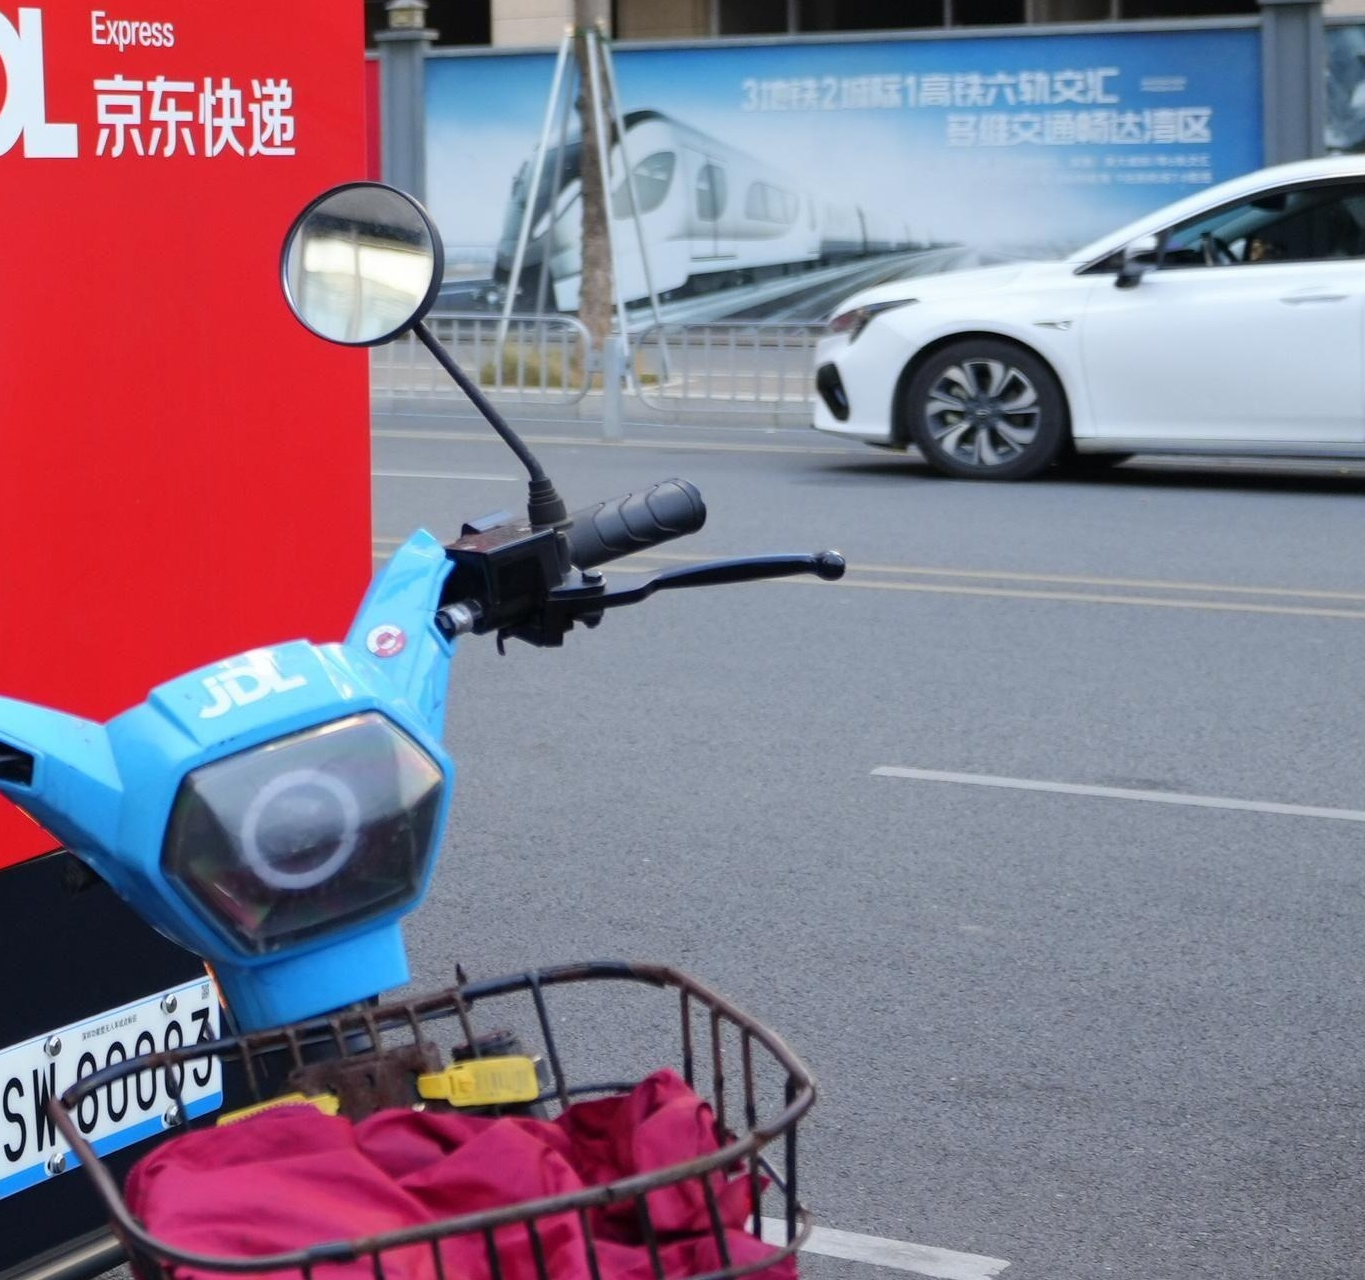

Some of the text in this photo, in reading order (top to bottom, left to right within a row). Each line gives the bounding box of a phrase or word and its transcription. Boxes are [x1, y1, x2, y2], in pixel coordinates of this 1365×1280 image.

[91, 10, 175, 53] Express
[93, 73, 296, 158] 京东快递
[198, 648, 308, 719] JDL
